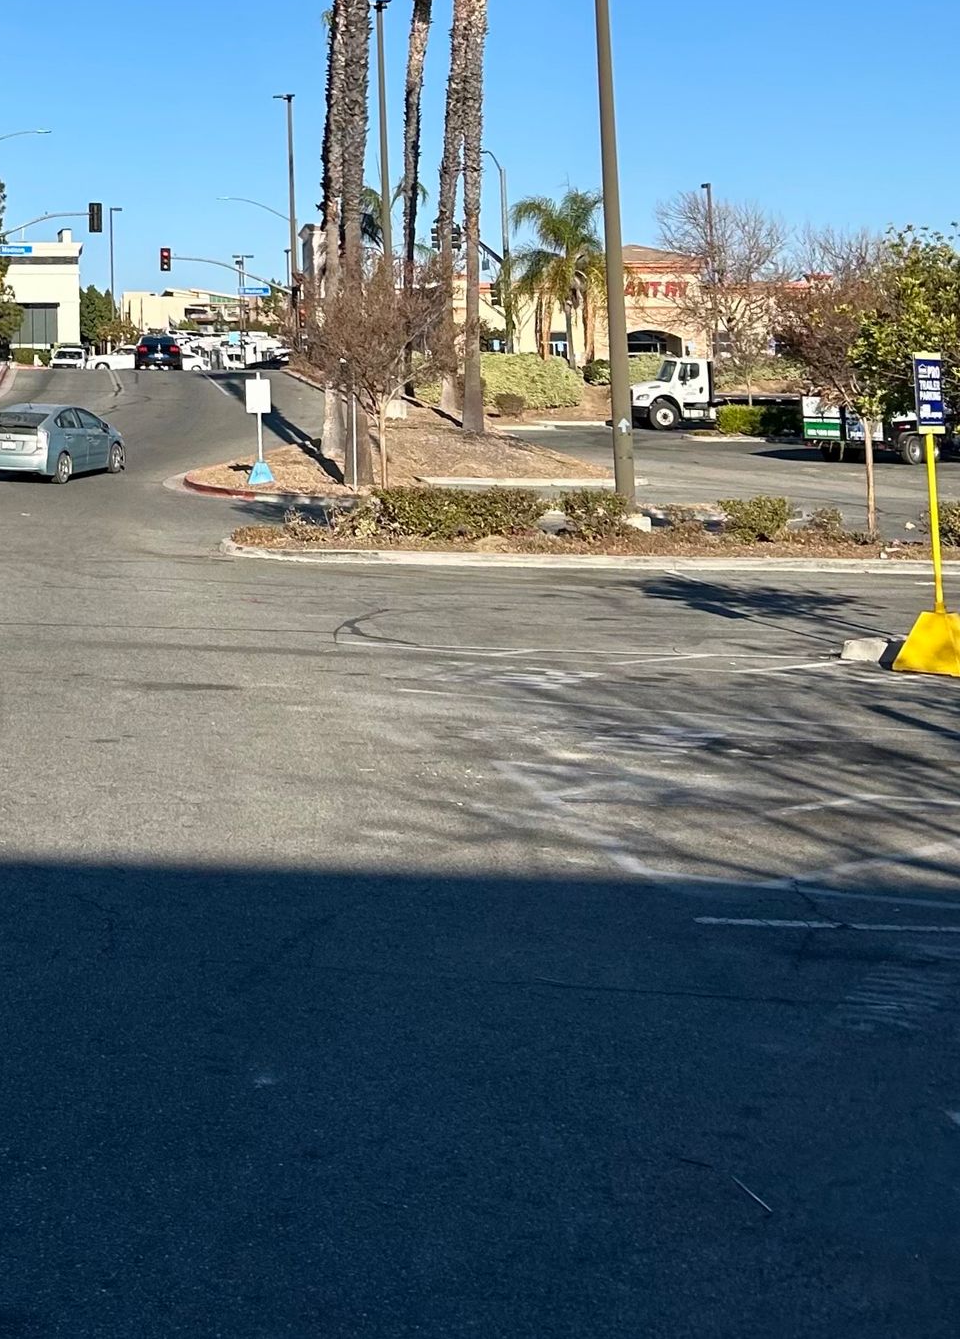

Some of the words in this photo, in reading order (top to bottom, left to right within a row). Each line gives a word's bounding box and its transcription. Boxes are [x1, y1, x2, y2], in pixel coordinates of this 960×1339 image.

[927, 366, 940, 379] PRO
[919, 380, 941, 390] TRAILER
[919, 391, 941, 401] PARKING
